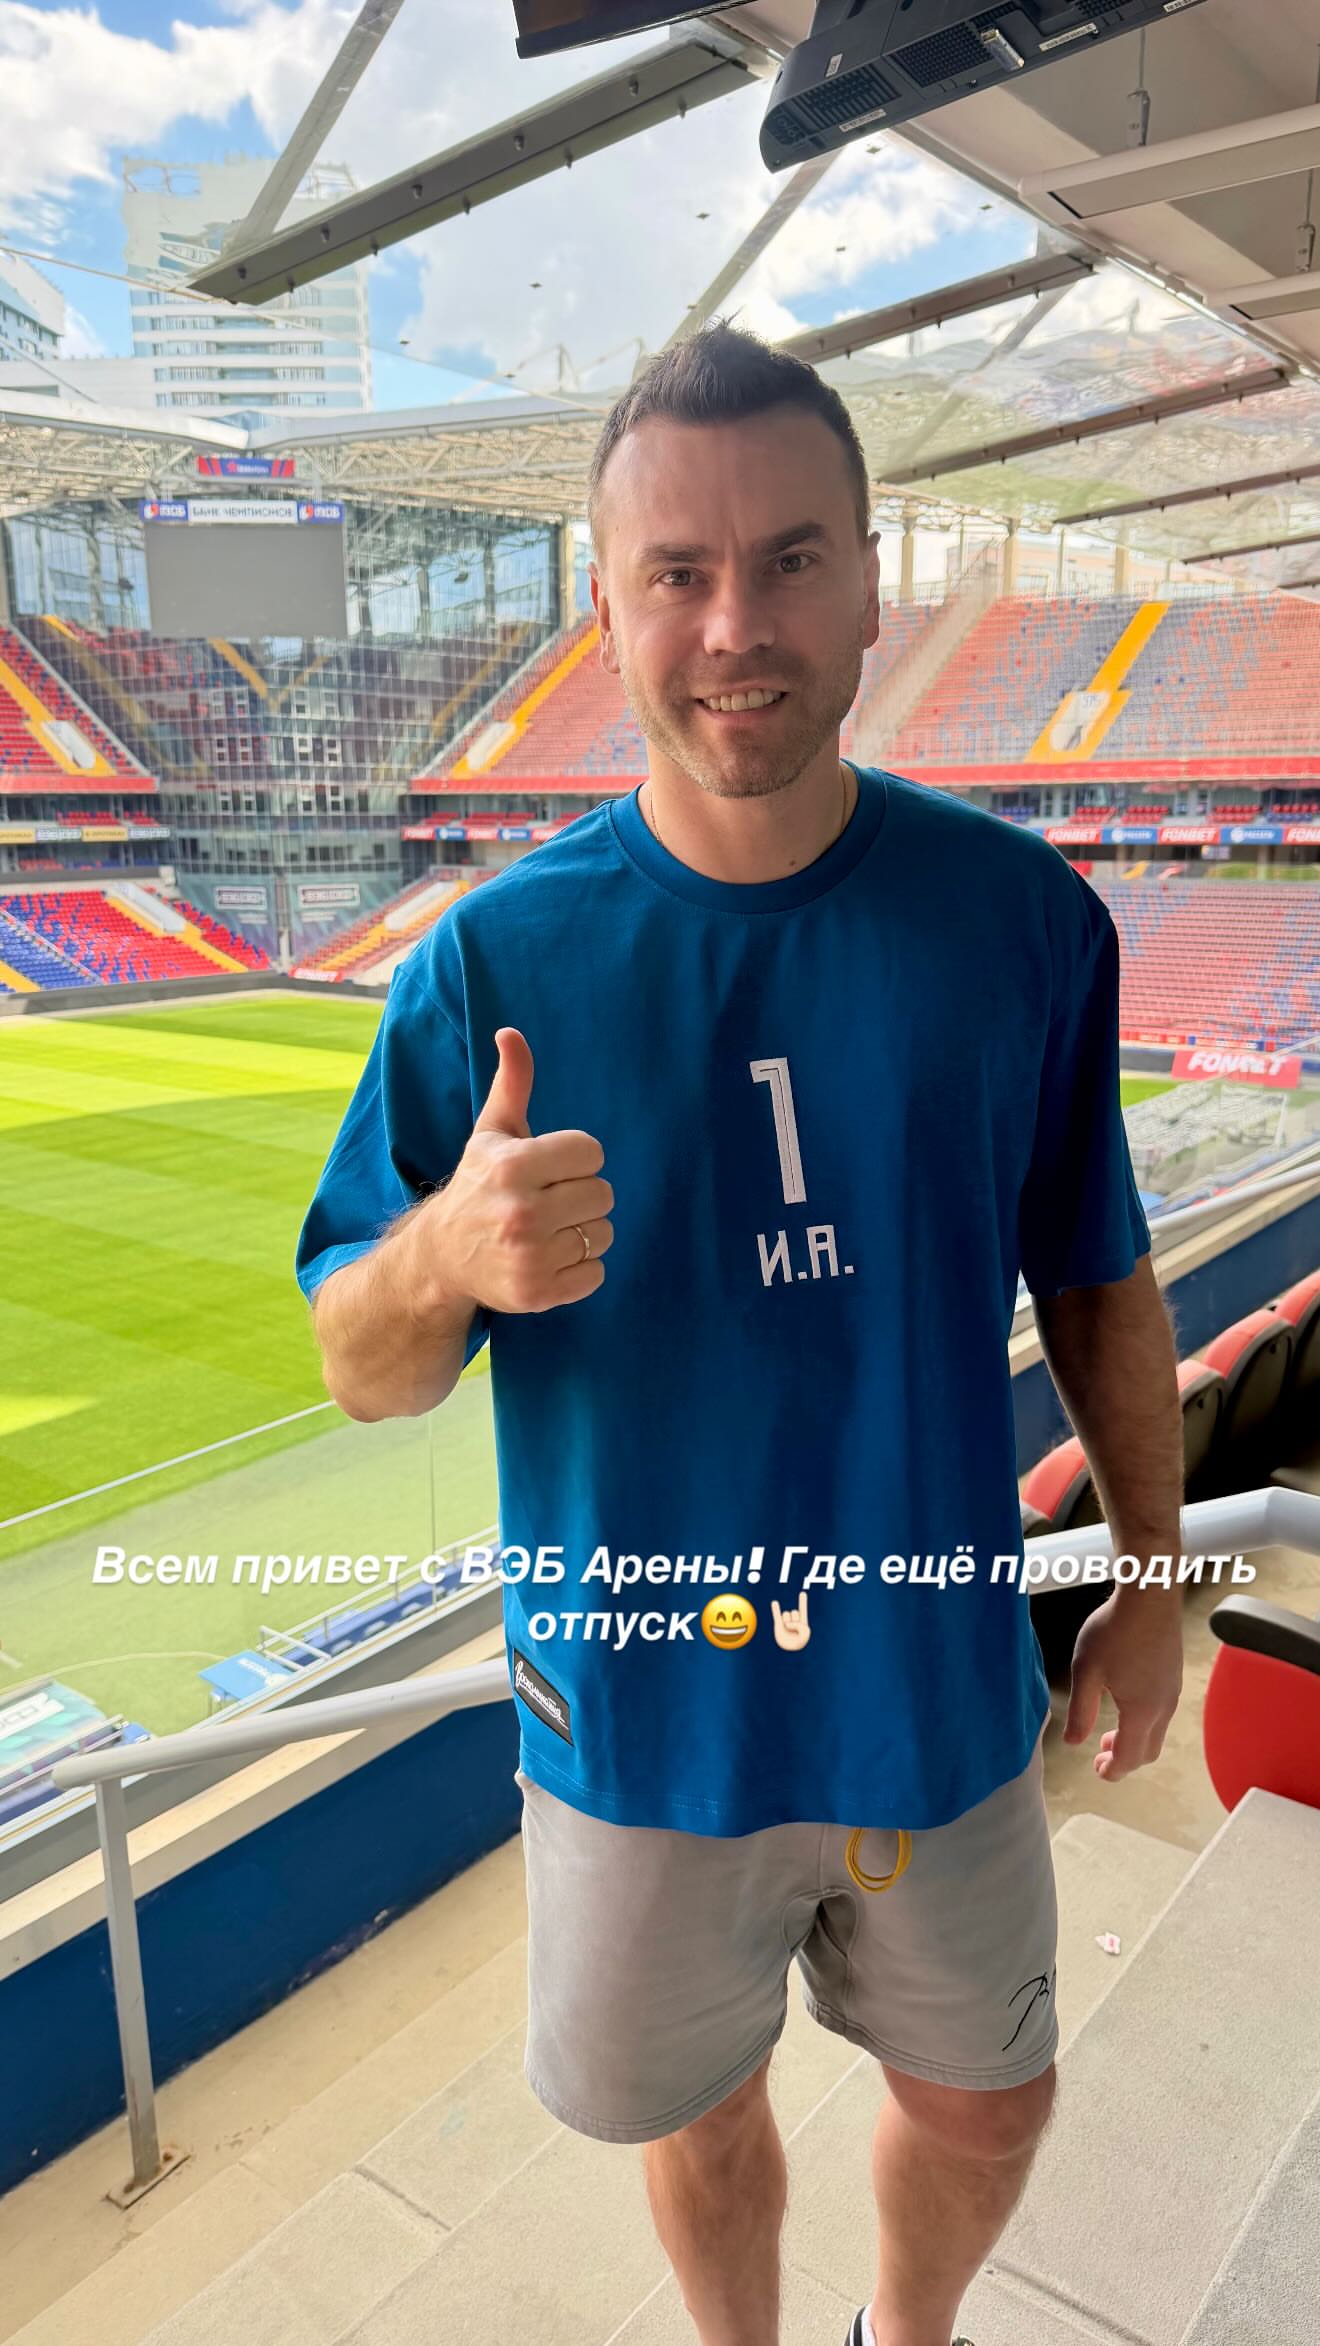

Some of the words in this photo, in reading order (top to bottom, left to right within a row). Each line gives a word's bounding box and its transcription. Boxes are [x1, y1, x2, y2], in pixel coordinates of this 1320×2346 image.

[224, 507, 294, 517] ЧЕМПИОНОВ
[1047, 828, 1098, 842] FONBET
[1161, 827, 1217, 842] FONBET
[750, 1057, 807, 1204] 1
[757, 1225, 854, 1287] И.А.
